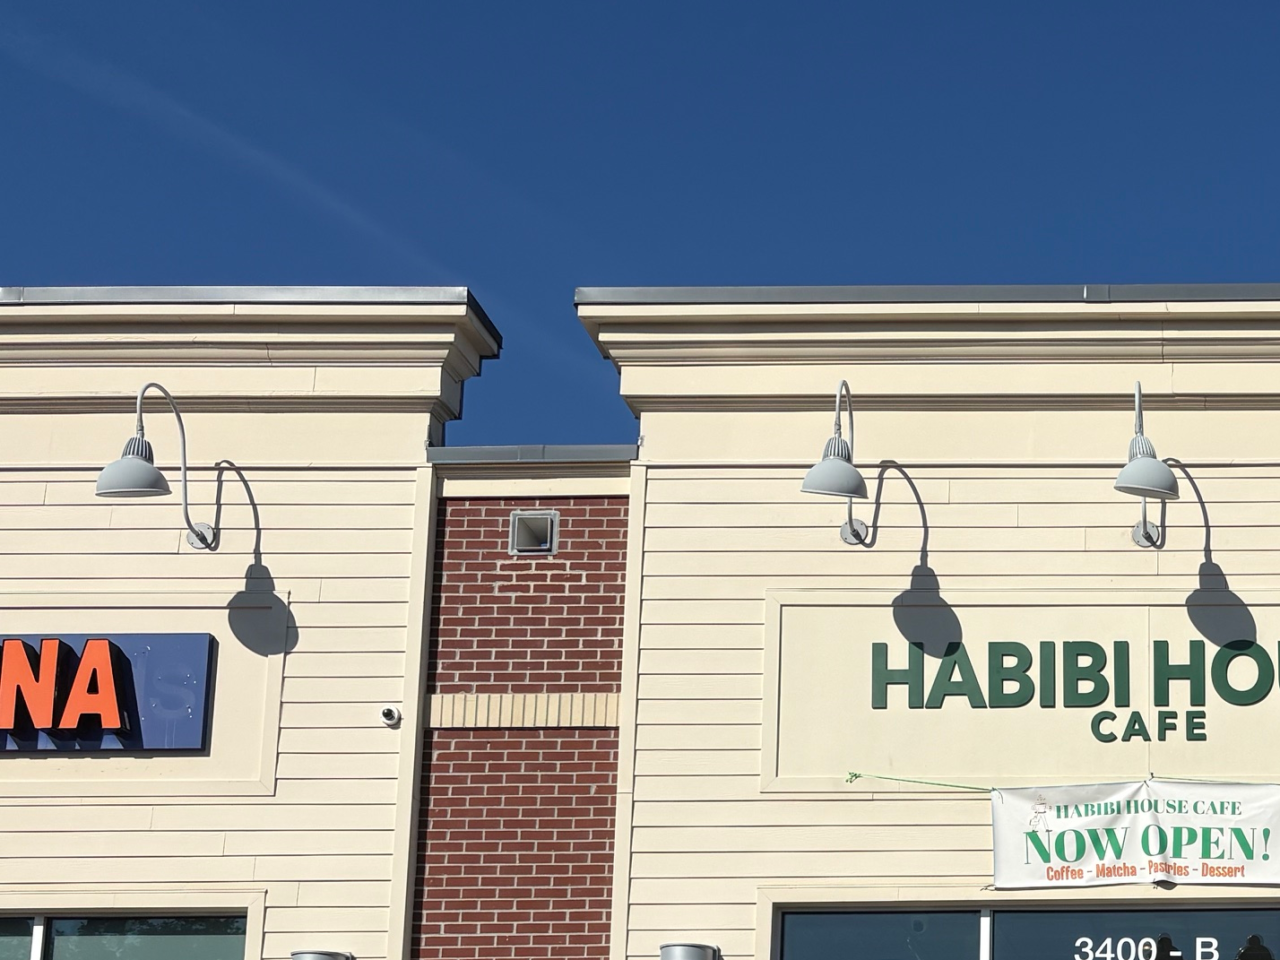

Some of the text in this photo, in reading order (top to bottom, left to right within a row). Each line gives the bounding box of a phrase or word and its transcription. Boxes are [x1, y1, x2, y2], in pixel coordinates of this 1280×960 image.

[871, 641, 1130, 710] HABIBI
[1090, 710, 1208, 743] CAFE
[1055, 798, 1243, 820] HABIBI HOUSE CAFE
[1023, 824, 1272, 865] NOW OPEN!
[1046, 865, 1085, 881] Coffee
[1095, 863, 1138, 878] Matcha
[1147, 859, 1190, 877] Pastries
[1201, 862, 1246, 878] Dessert
